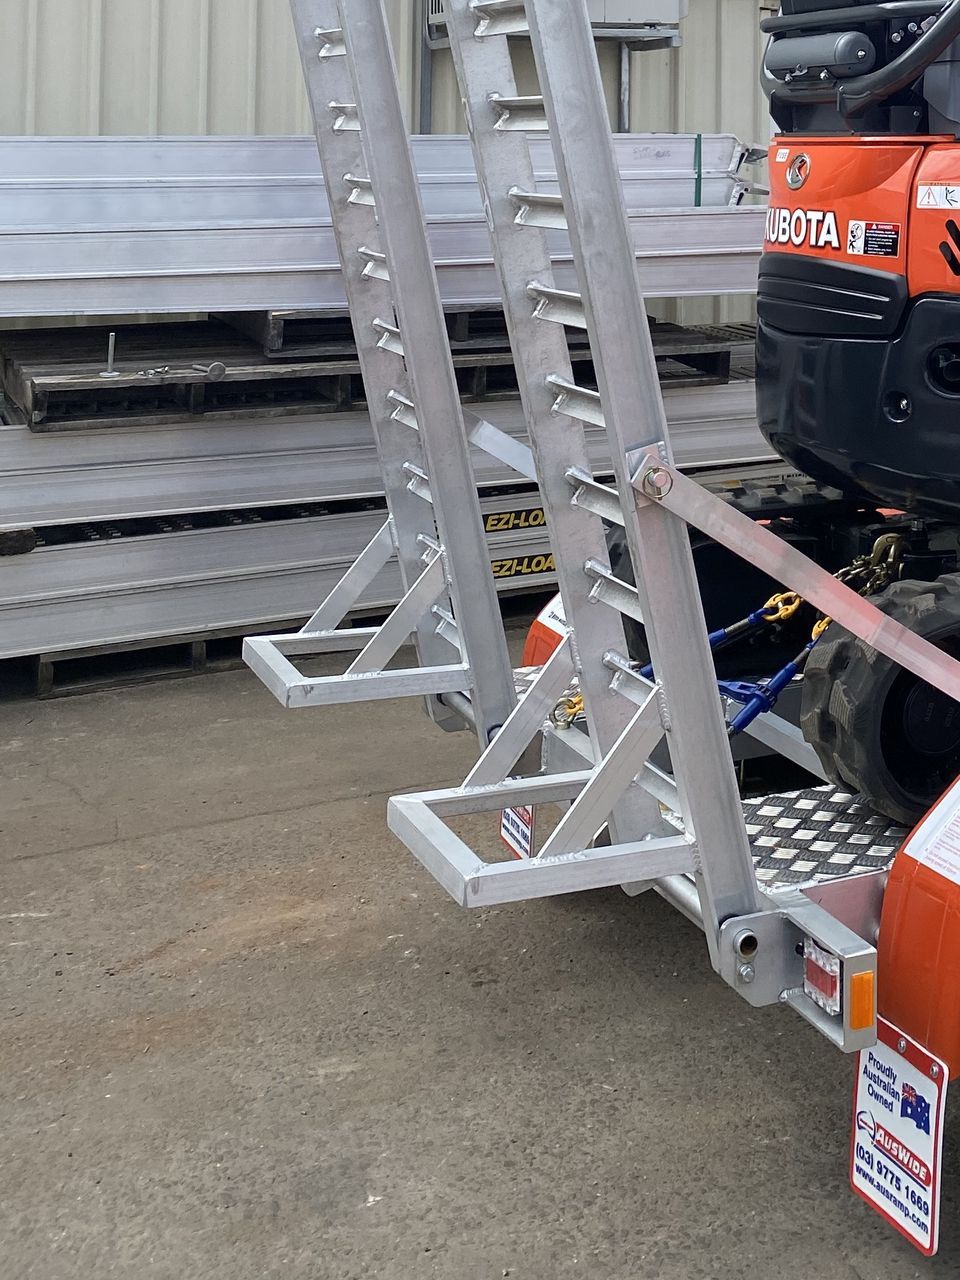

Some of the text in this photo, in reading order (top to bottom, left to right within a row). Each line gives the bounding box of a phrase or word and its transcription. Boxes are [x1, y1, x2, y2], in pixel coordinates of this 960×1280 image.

[862, 1064, 901, 1102] Australian
[868, 1052, 897, 1085] Proudly
[867, 1083, 894, 1113] Owned
[855, 1162, 929, 1235] www.ausramp.com
[856, 1142, 929, 1217] (03) 9775 1669
